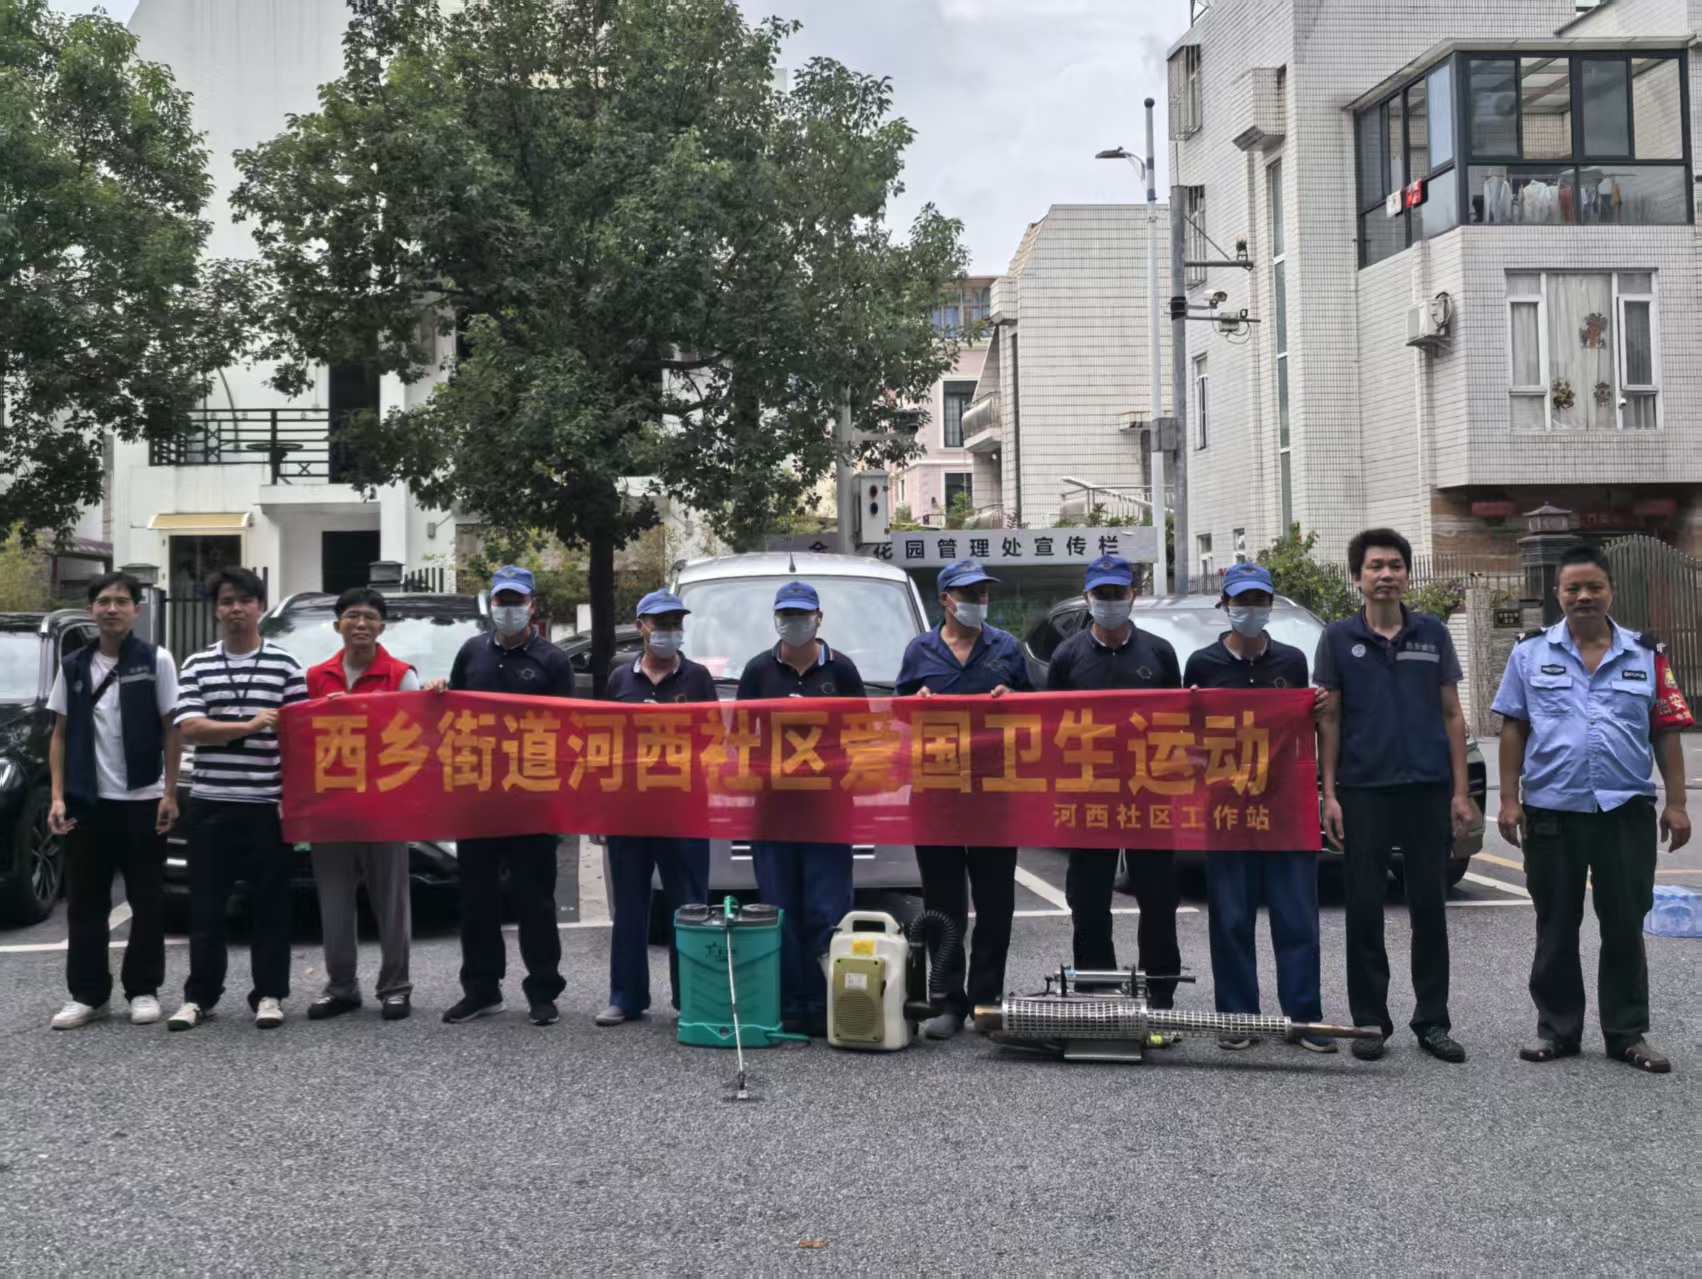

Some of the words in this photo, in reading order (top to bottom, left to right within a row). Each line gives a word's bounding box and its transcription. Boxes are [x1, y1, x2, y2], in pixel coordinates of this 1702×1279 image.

[311, 707, 1270, 796] 西乡街道河西社区爱国卫生运动
[1053, 803, 1270, 831] 河西社区工作站
